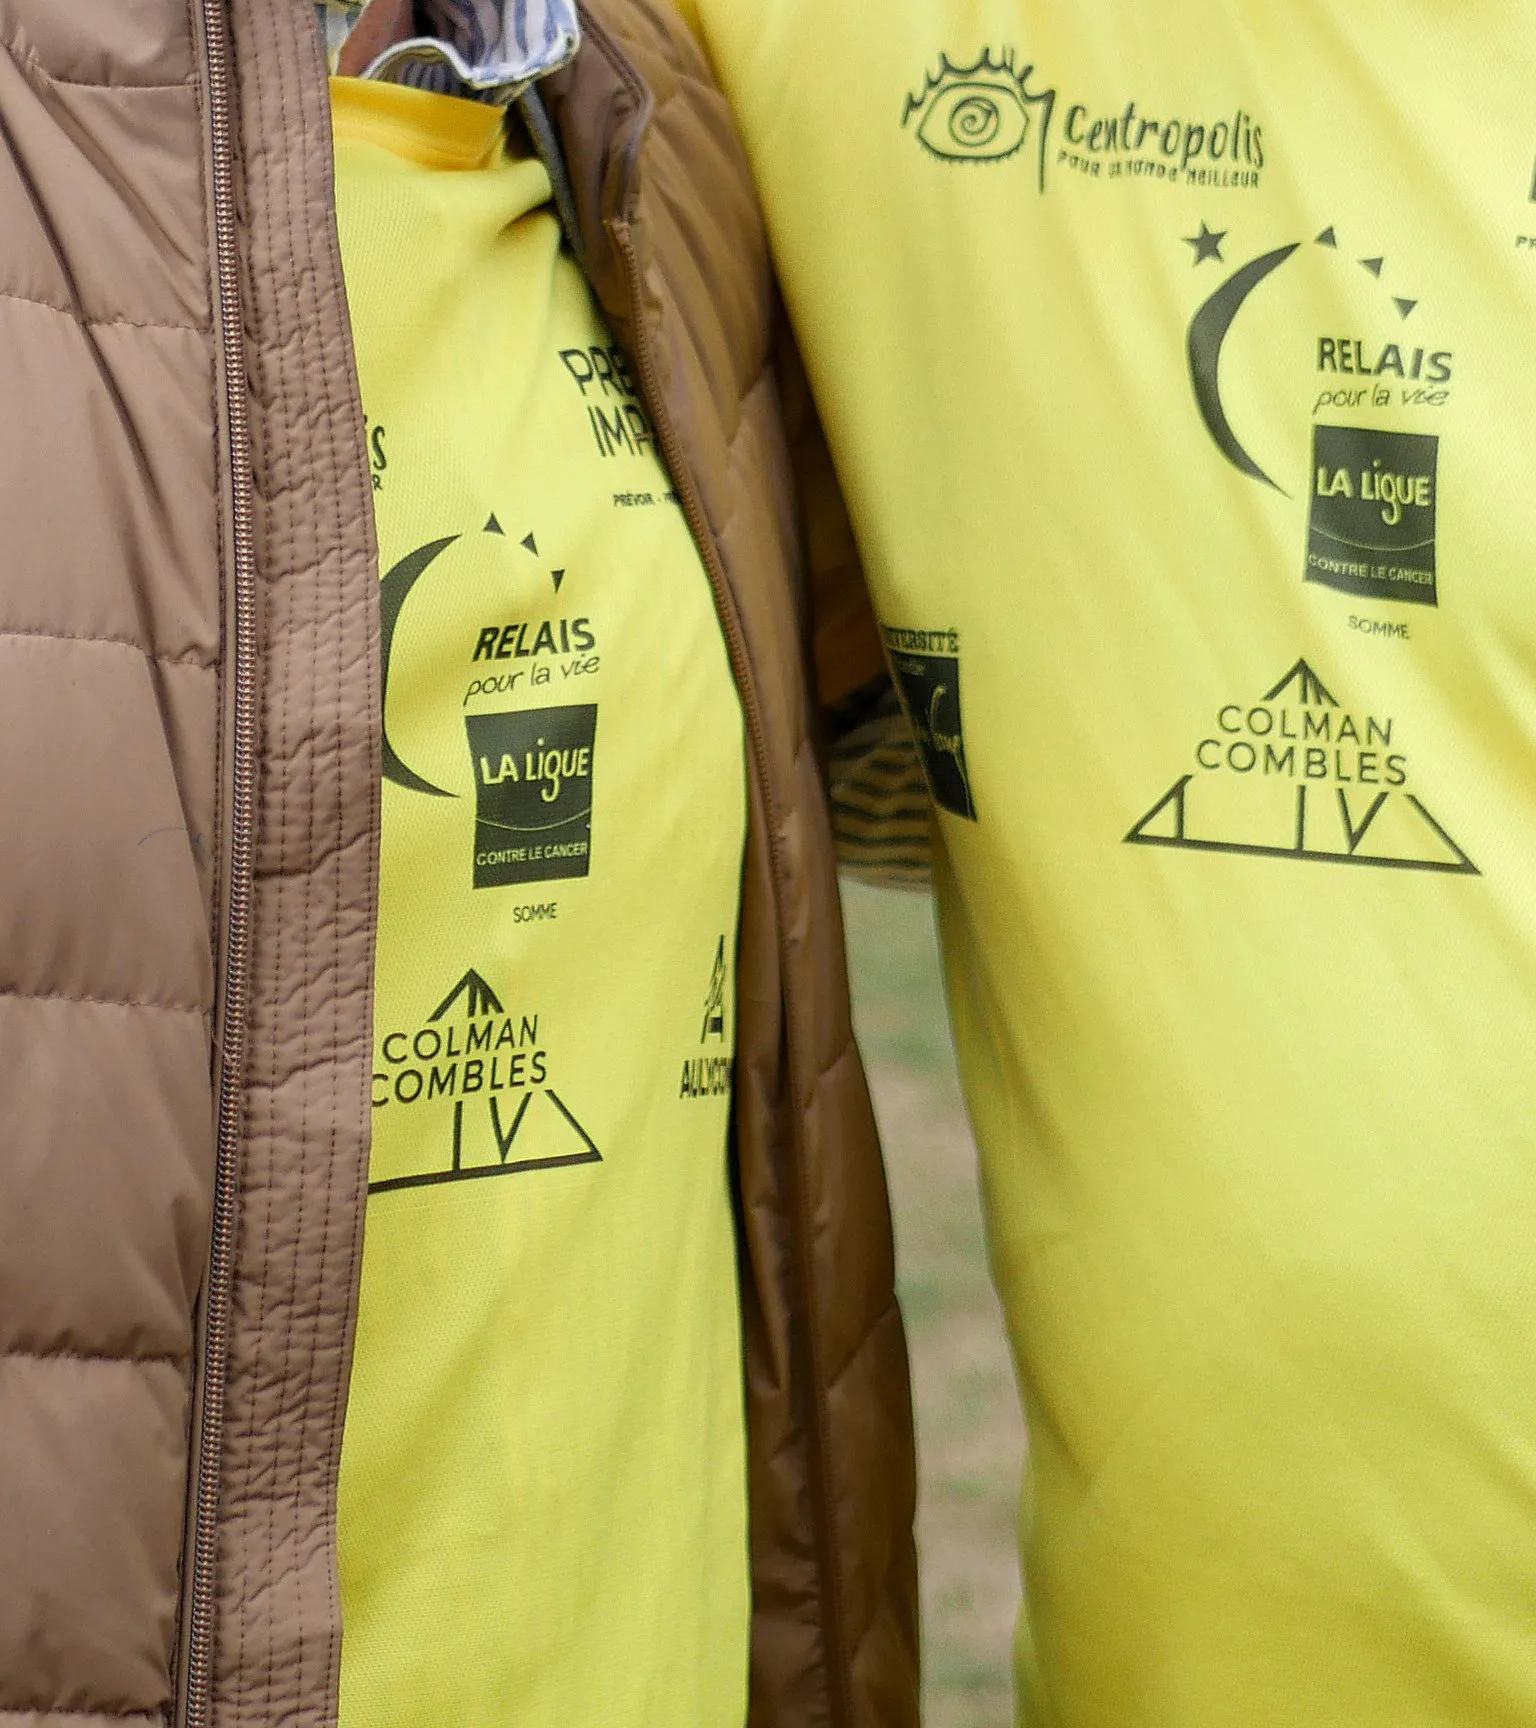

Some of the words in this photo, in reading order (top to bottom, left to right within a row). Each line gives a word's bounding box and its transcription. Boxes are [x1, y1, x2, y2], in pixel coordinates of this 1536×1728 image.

[1064, 102, 1264, 169] Centropolis
[1057, 149, 1101, 178] POUR
[1186, 166, 1260, 189] MEILLEUR
[1317, 337, 1453, 383] RELAIS
[1312, 388, 1368, 416] pour
[1372, 383, 1391, 408] la
[1401, 386, 1450, 407] vie
[1316, 466, 1353, 499] LA
[1308, 553, 1369, 579] CONTRE
[1370, 566, 1385, 580] LE
[1387, 566, 1434, 586] CANCER
[472, 618, 596, 662] RELAIS
[1347, 614, 1411, 641] SOMME
[463, 671, 525, 707] pour
[530, 662, 551, 686] la
[560, 652, 601, 679] vie
[1218, 704, 1392, 747] COLMAN
[479, 752, 520, 785] LA
[1196, 738, 1407, 787] COMBLES
[476, 846, 526, 867] CONTRE
[528, 846, 543, 861] LE
[544, 841, 588, 860] CANCER
[513, 902, 558, 924] SOMME
[382, 1014, 539, 1065] COLMAN
[371, 1050, 548, 1108] COMBLES
